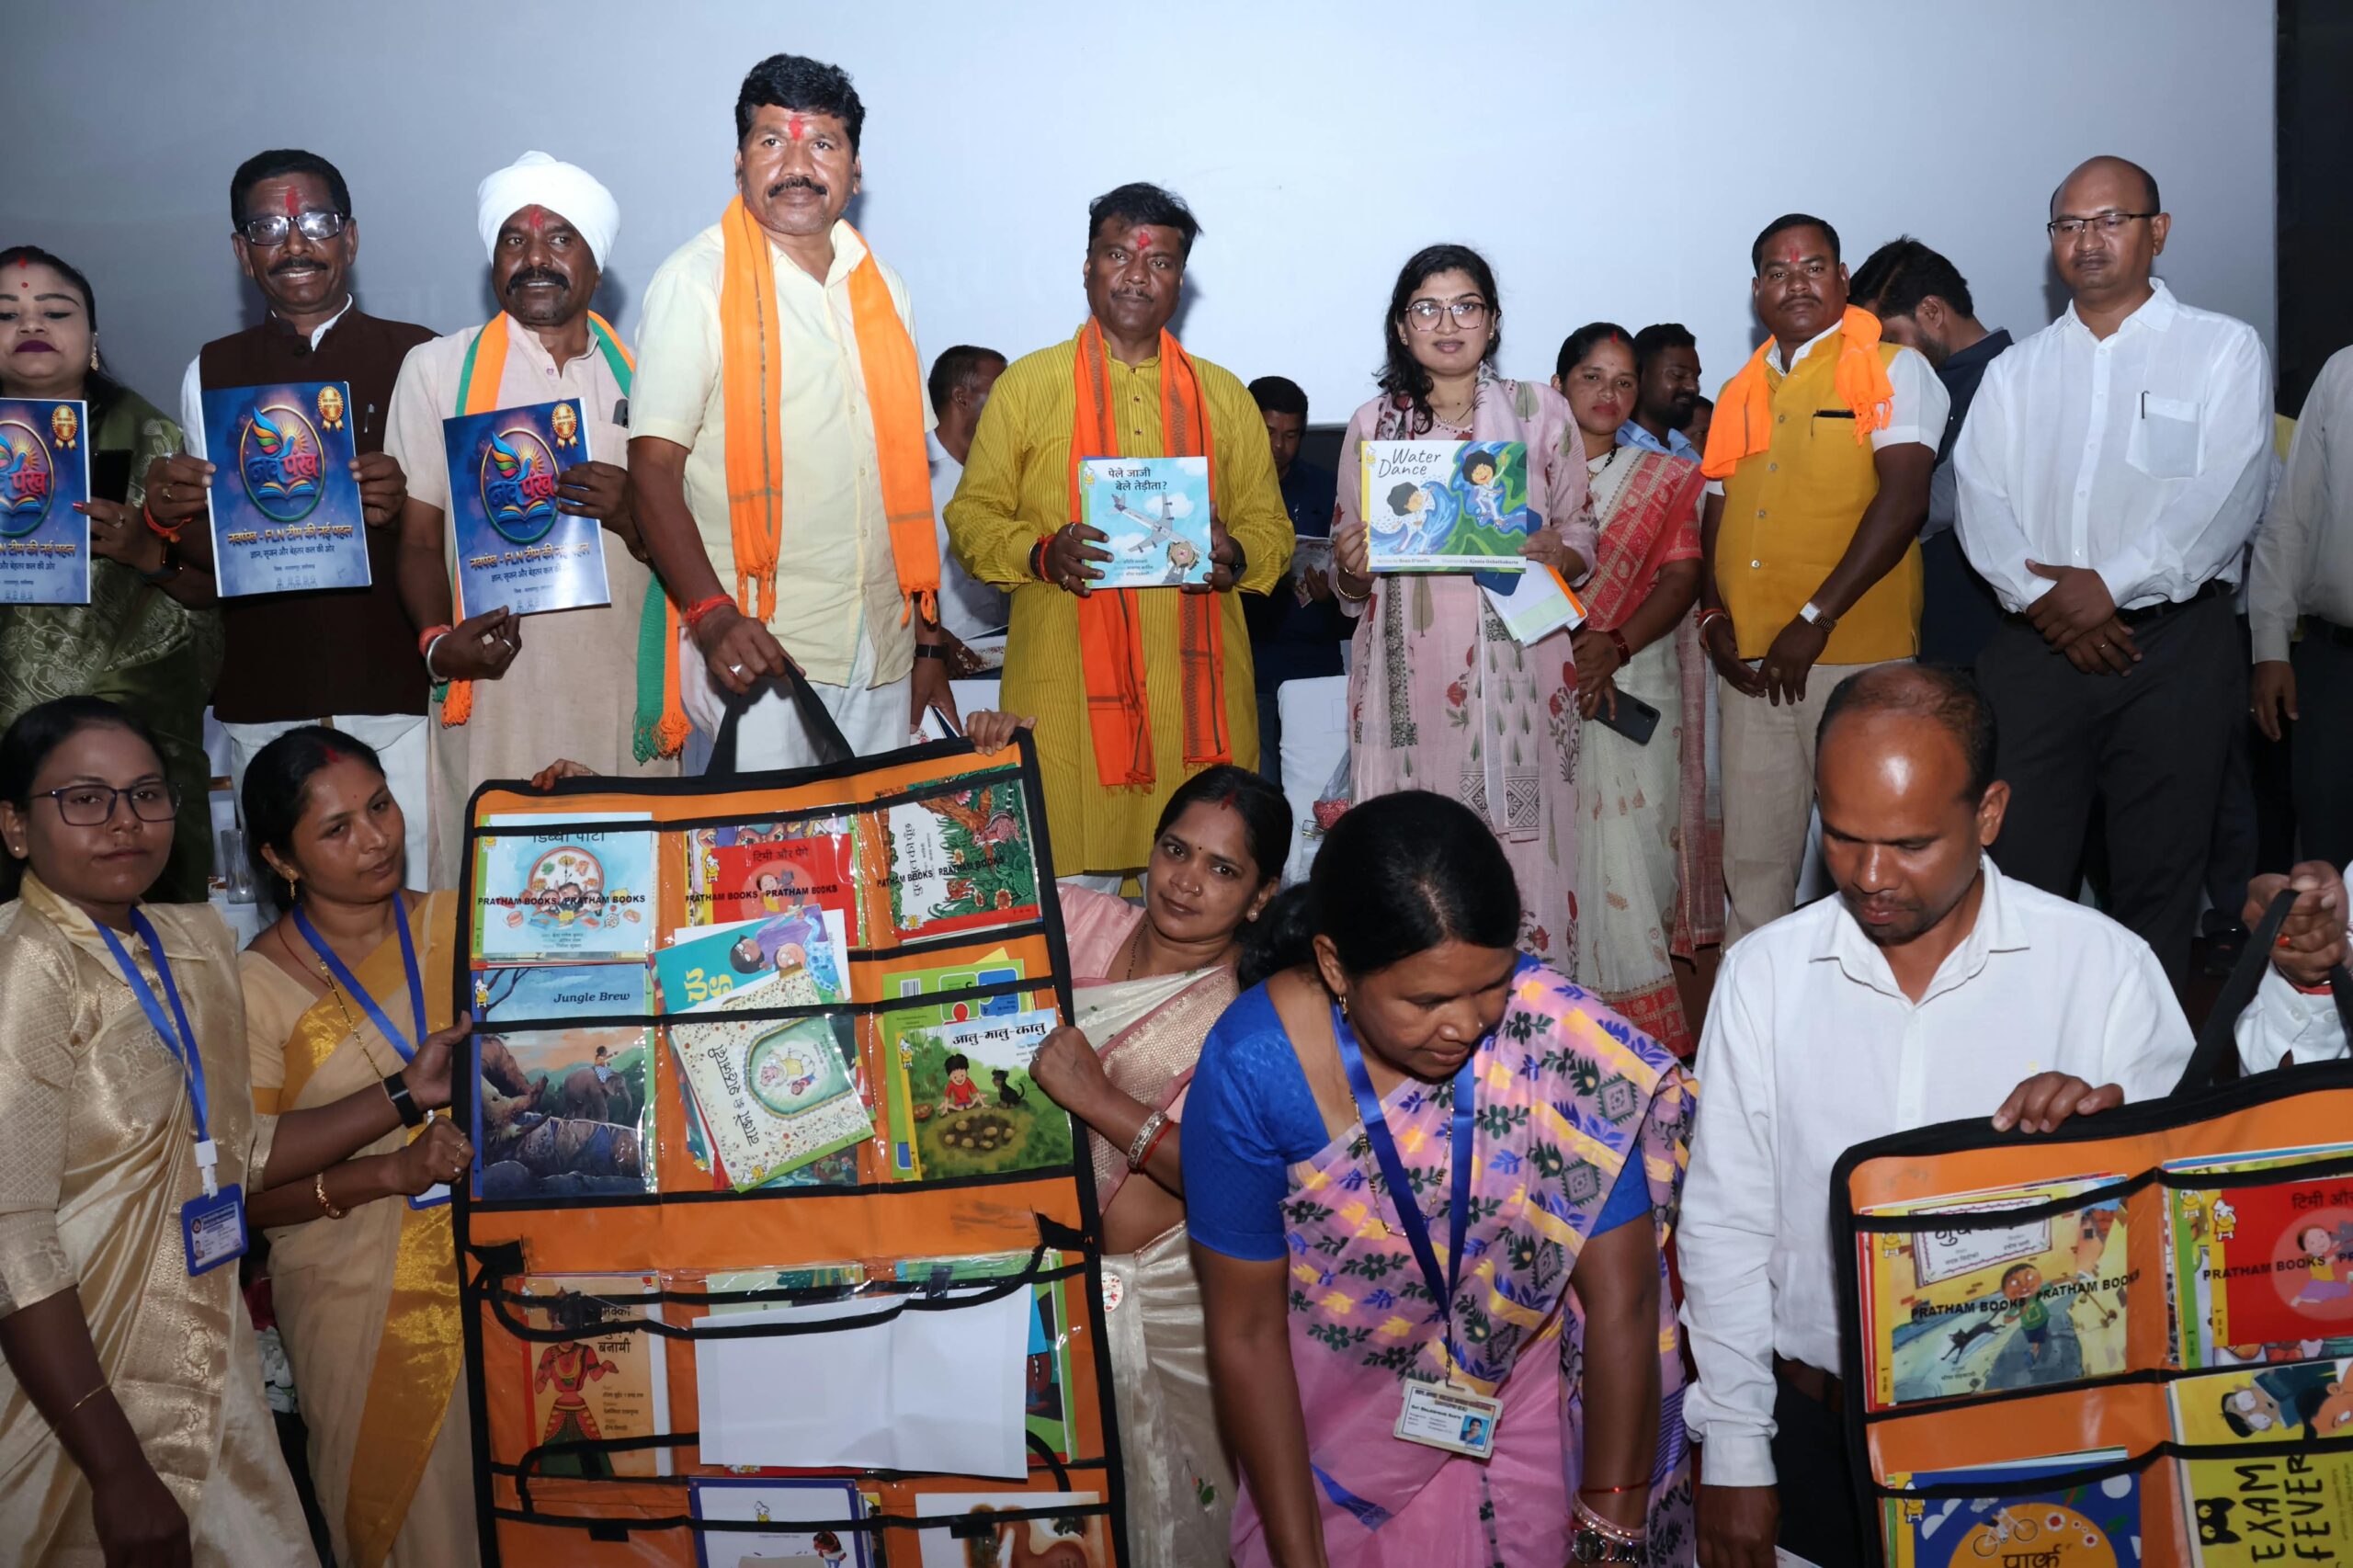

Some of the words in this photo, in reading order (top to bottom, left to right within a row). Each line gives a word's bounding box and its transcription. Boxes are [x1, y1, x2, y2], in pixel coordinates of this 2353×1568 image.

[283, 449, 319, 478] पंख
[1392, 448, 1441, 465] Water
[1108, 467, 1123, 479] पेले
[1126, 467, 1151, 478] जाजी
[1378, 458, 1427, 478] Dance
[11, 464, 48, 495] पंख
[520, 469, 556, 497] पंख
[1115, 480, 1131, 492] बेले
[938, 863, 973, 875] PRATHAM
[975, 857, 1005, 869] BOOKS
[478, 897, 523, 906] PRATHAM
[524, 896, 557, 905] BOOKS
[565, 895, 610, 905] PRATHAM
[612, 894, 646, 903] BOOKS
[685, 893, 726, 903] PRATHAM
[727, 891, 758, 900] BOOKS
[766, 888, 809, 897] PRATHAM
[811, 884, 838, 895] BOOKS
[553, 992, 596, 1005] Jungle
[599, 991, 631, 1002] Brew
[2202, 1264, 2272, 1281] PRATHAM
[2276, 1256, 2326, 1272] BOOKS
[1911, 1301, 1976, 1320] PRATHAM
[1980, 1297, 2027, 1313] BOOKS
[2036, 1280, 2097, 1302] PRATHAM
[597, 1337, 631, 1354] बनायी
[2234, 1463, 2286, 1563] EXAM
[2284, 1452, 2336, 1562] FEVER
[2002, 1543, 2061, 1568] पार्क
